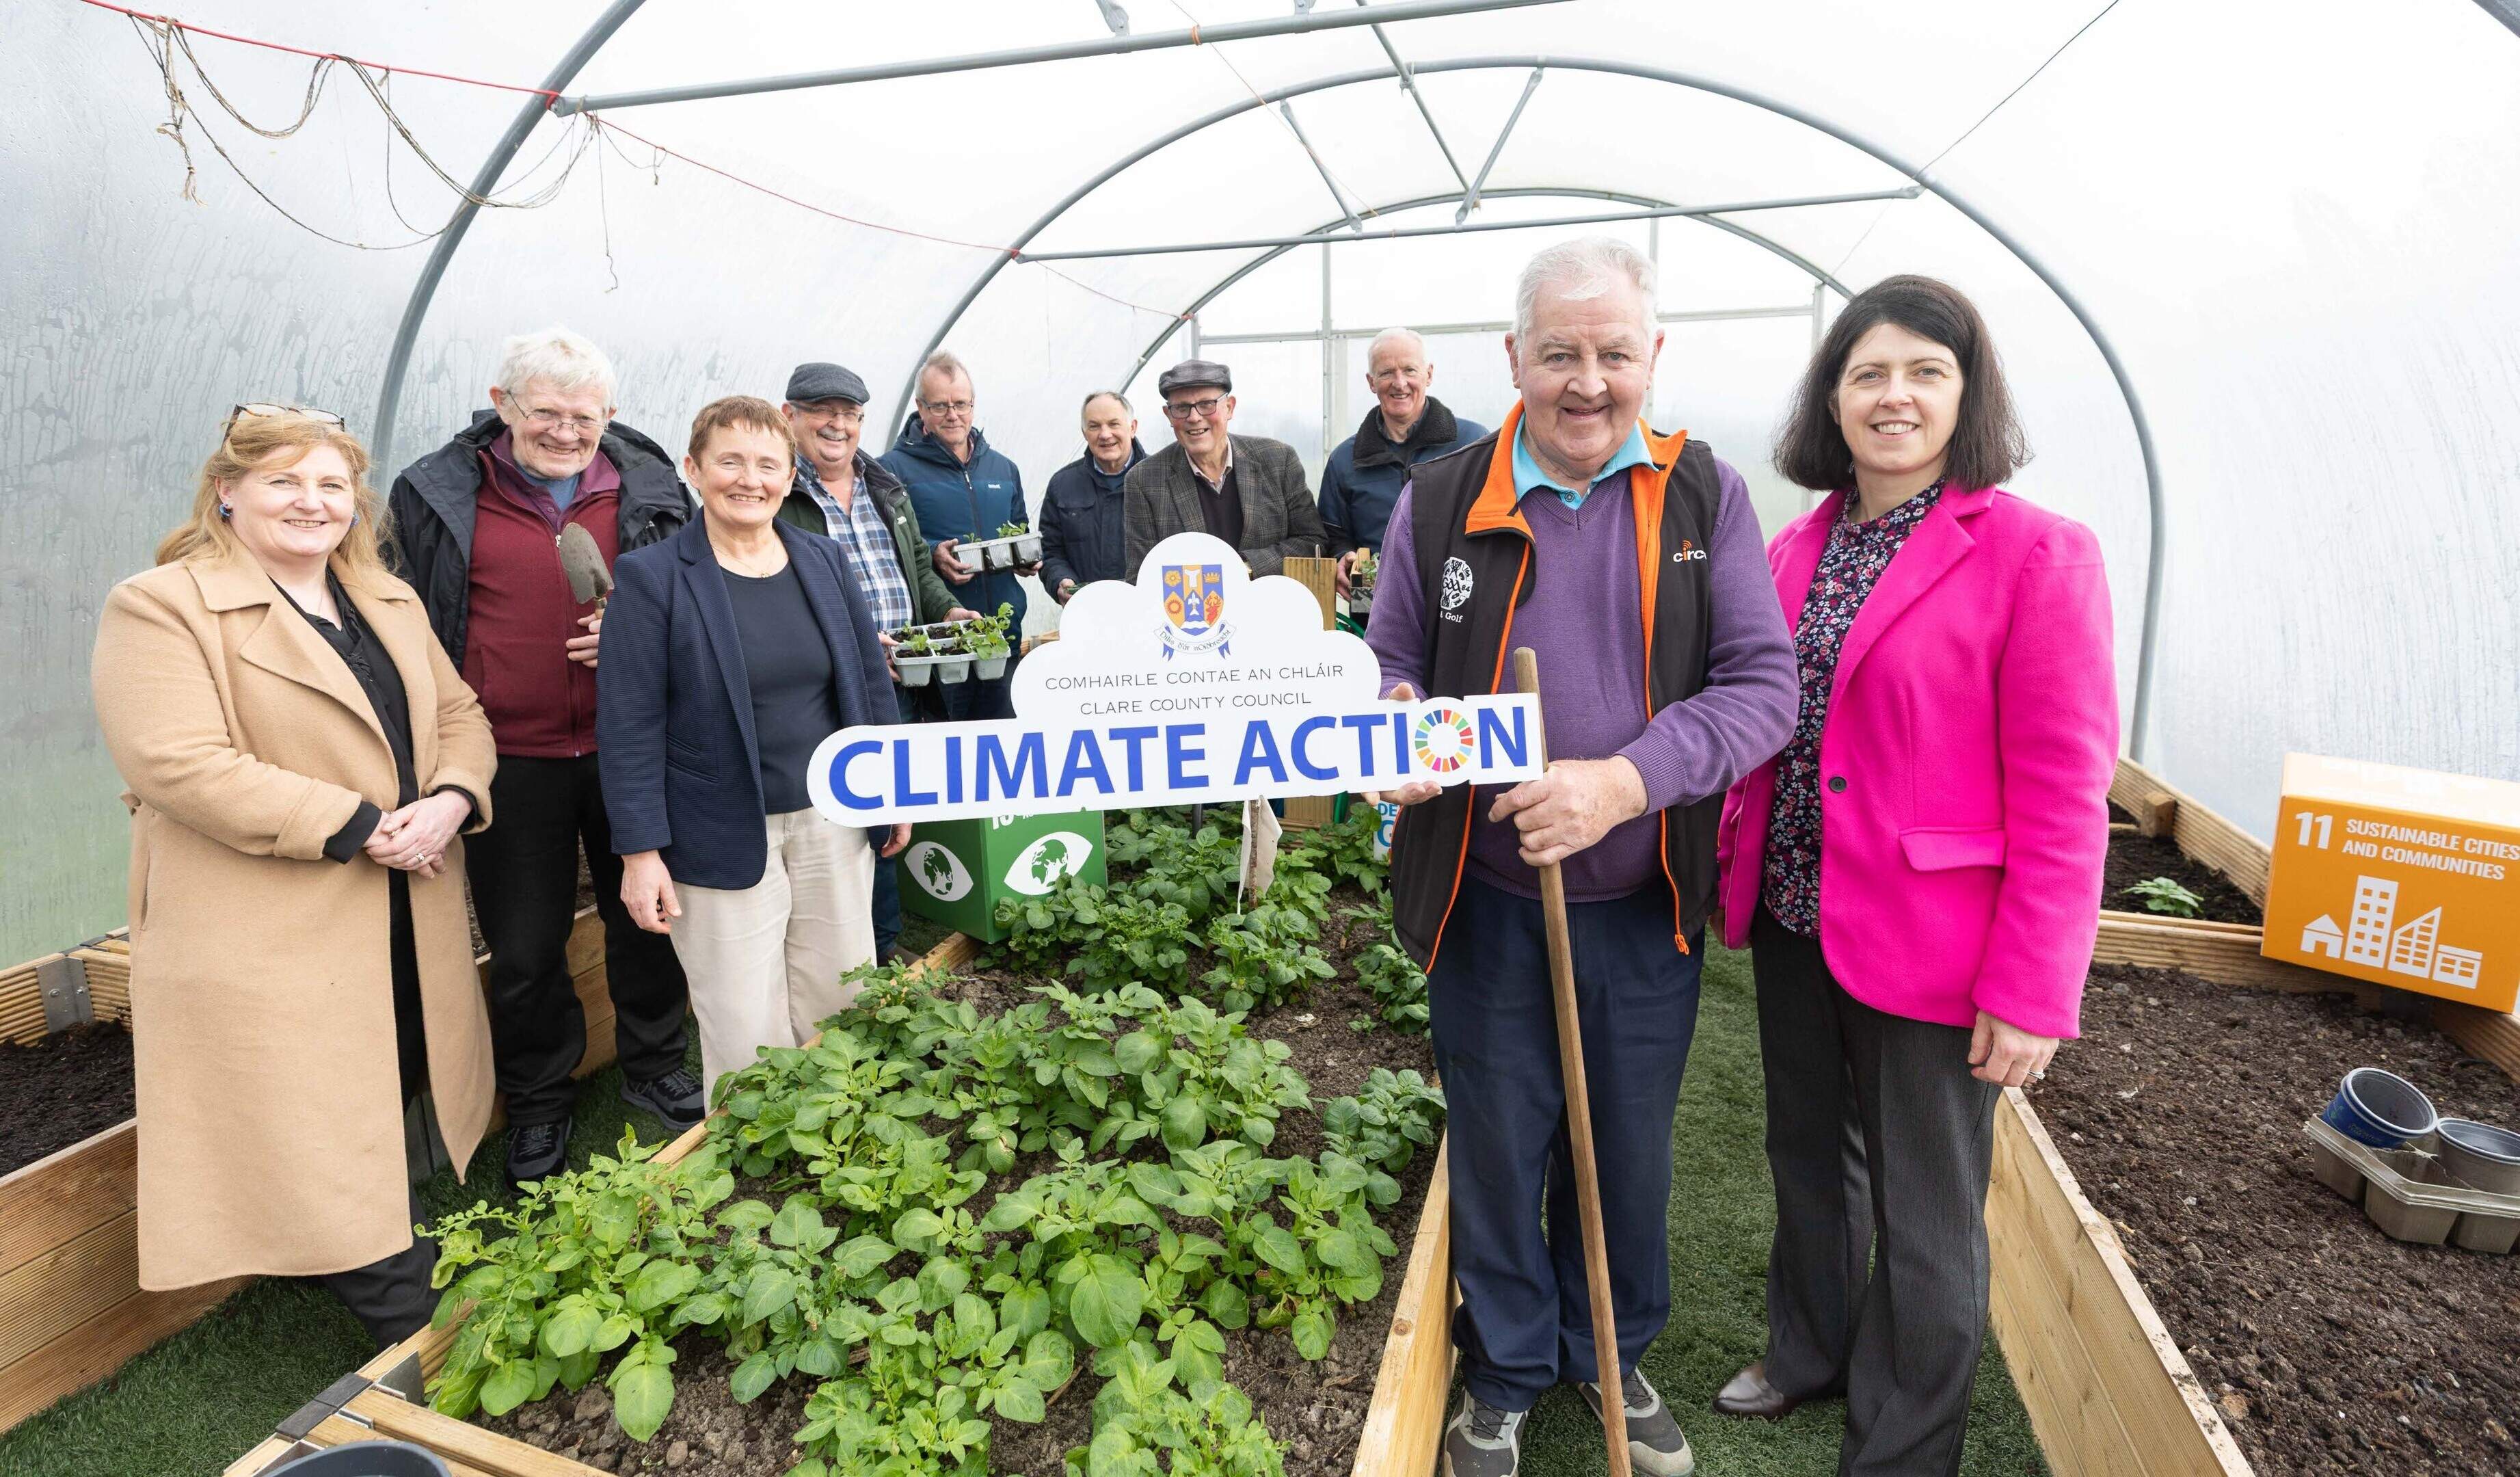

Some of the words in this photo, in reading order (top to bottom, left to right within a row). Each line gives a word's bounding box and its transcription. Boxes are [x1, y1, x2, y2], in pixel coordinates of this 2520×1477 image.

[1673, 546, 1707, 562] circ
[1445, 612, 1464, 623] Golf
[1045, 673, 1157, 690] COMHAIRLE
[1166, 669, 1241, 684] CONTAE
[1248, 668, 1271, 681] AN
[1278, 662, 1343, 679] CHLÁIR
[1080, 700, 1142, 715] CLARE
[1150, 696, 1224, 712] COUNTY
[1232, 692, 1311, 708] COUNCIL
[829, 723, 1209, 810] CLIMATE
[1233, 706, 1528, 786] ACTION
[2295, 812, 2333, 850] 11
[2346, 819, 2461, 851] SUSTAINABLE
[2463, 838, 2520, 861] CITIES
[2342, 840, 2378, 858] AND
[2381, 846, 2505, 880] COMMUNITIES
